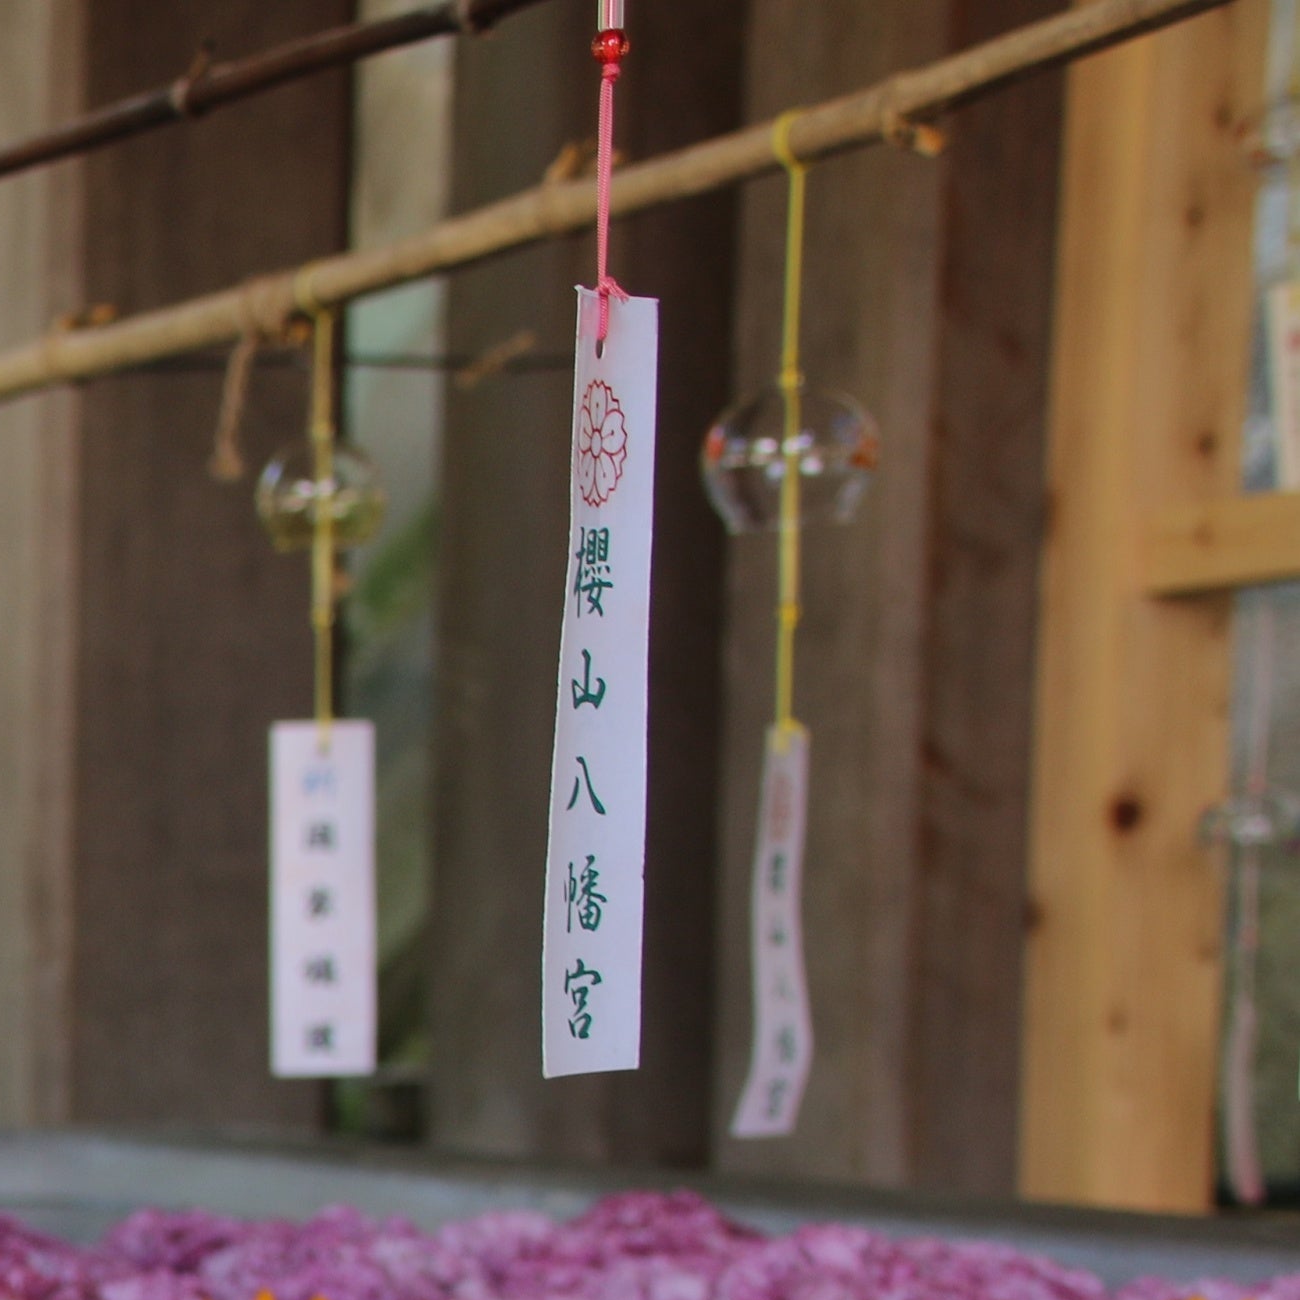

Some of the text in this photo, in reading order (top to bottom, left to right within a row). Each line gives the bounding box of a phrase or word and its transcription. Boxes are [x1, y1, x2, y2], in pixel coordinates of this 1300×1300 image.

[563, 526, 614, 1041] 櫻山八幡宮
